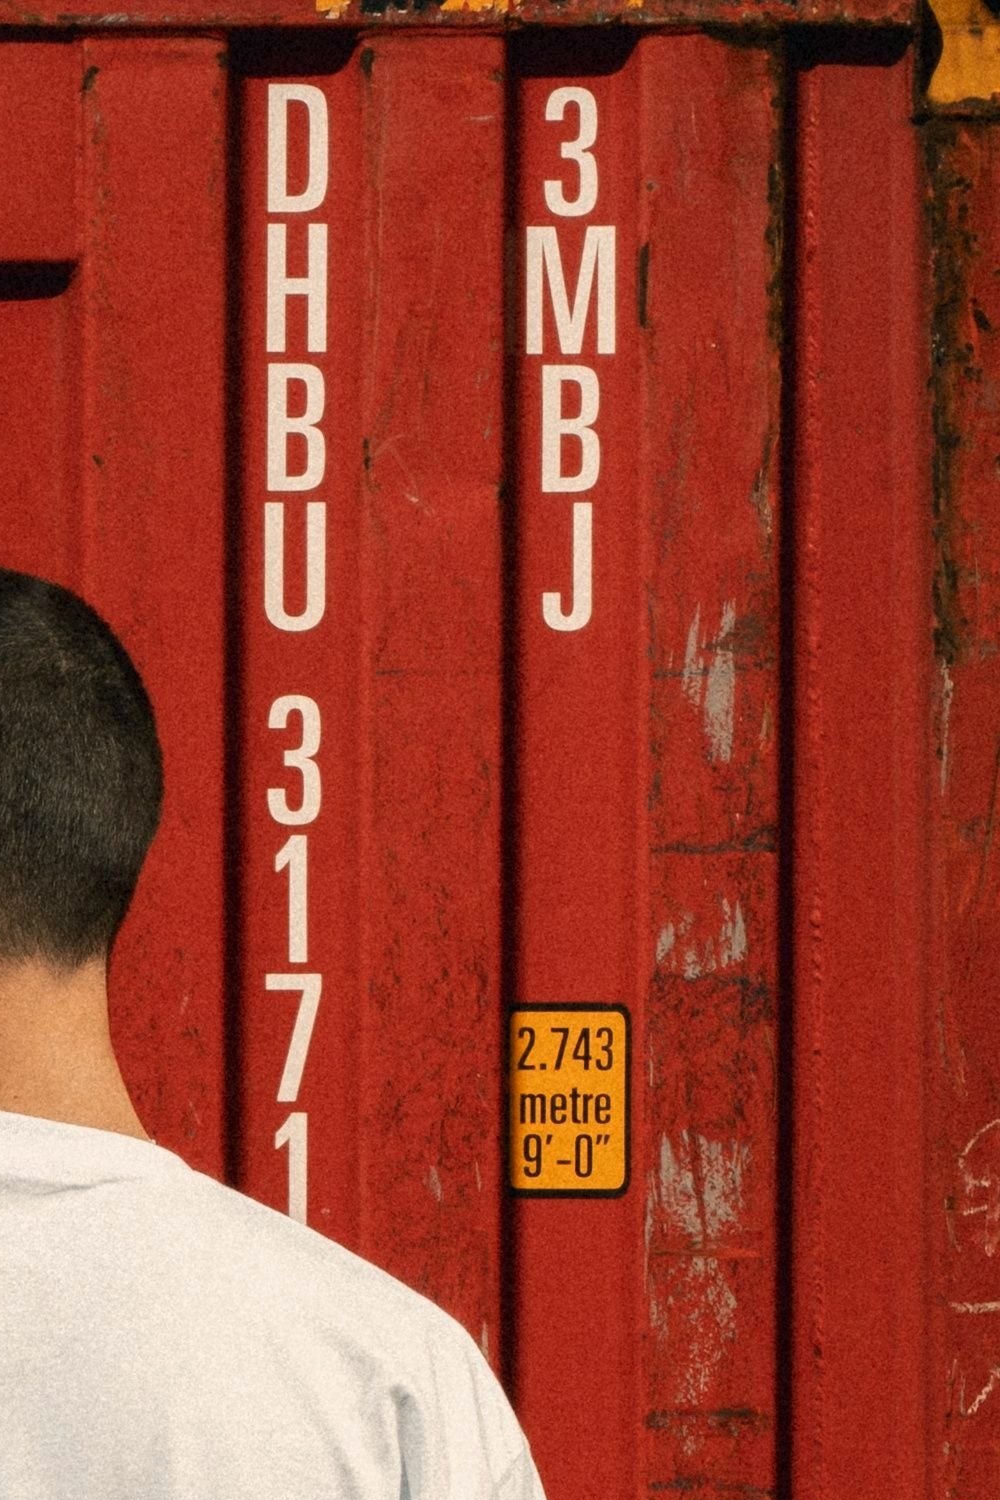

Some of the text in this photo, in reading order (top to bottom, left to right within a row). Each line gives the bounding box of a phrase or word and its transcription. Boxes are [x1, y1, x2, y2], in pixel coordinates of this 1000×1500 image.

[264, 83, 329, 632] DHBU
[526, 86, 617, 632] 3MBJ
[517, 1026, 614, 1071] 2.743
[519, 1087, 612, 1125] metre
